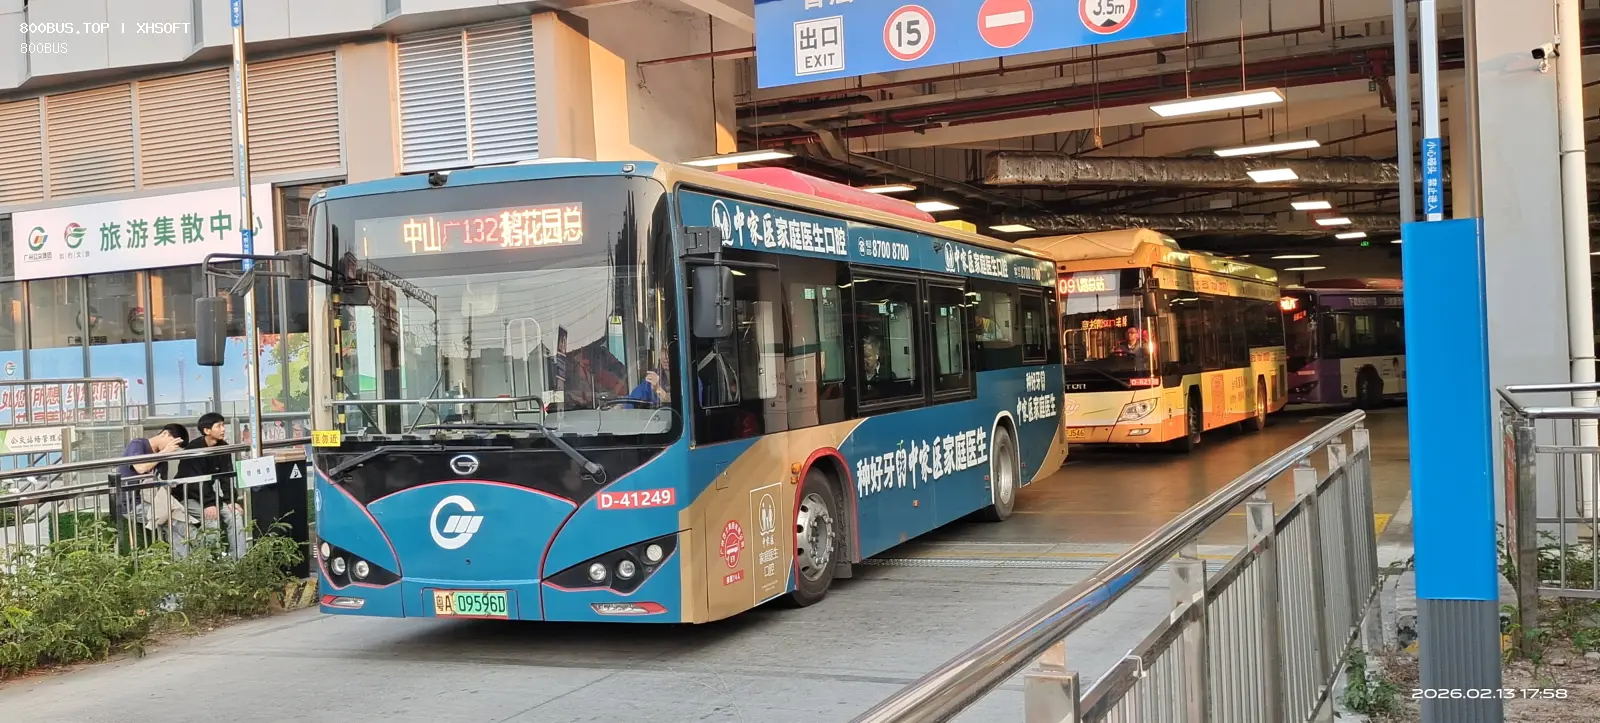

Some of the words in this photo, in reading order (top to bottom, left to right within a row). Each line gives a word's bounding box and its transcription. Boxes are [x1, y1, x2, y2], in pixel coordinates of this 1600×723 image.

[800, 27, 838, 50] 出口
[895, 19, 921, 47] 15
[805, 53, 835, 68] EXIT
[872, 239, 890, 259] 8700
[892, 242, 910, 261] 8700
[600, 490, 672, 508] D-41249
